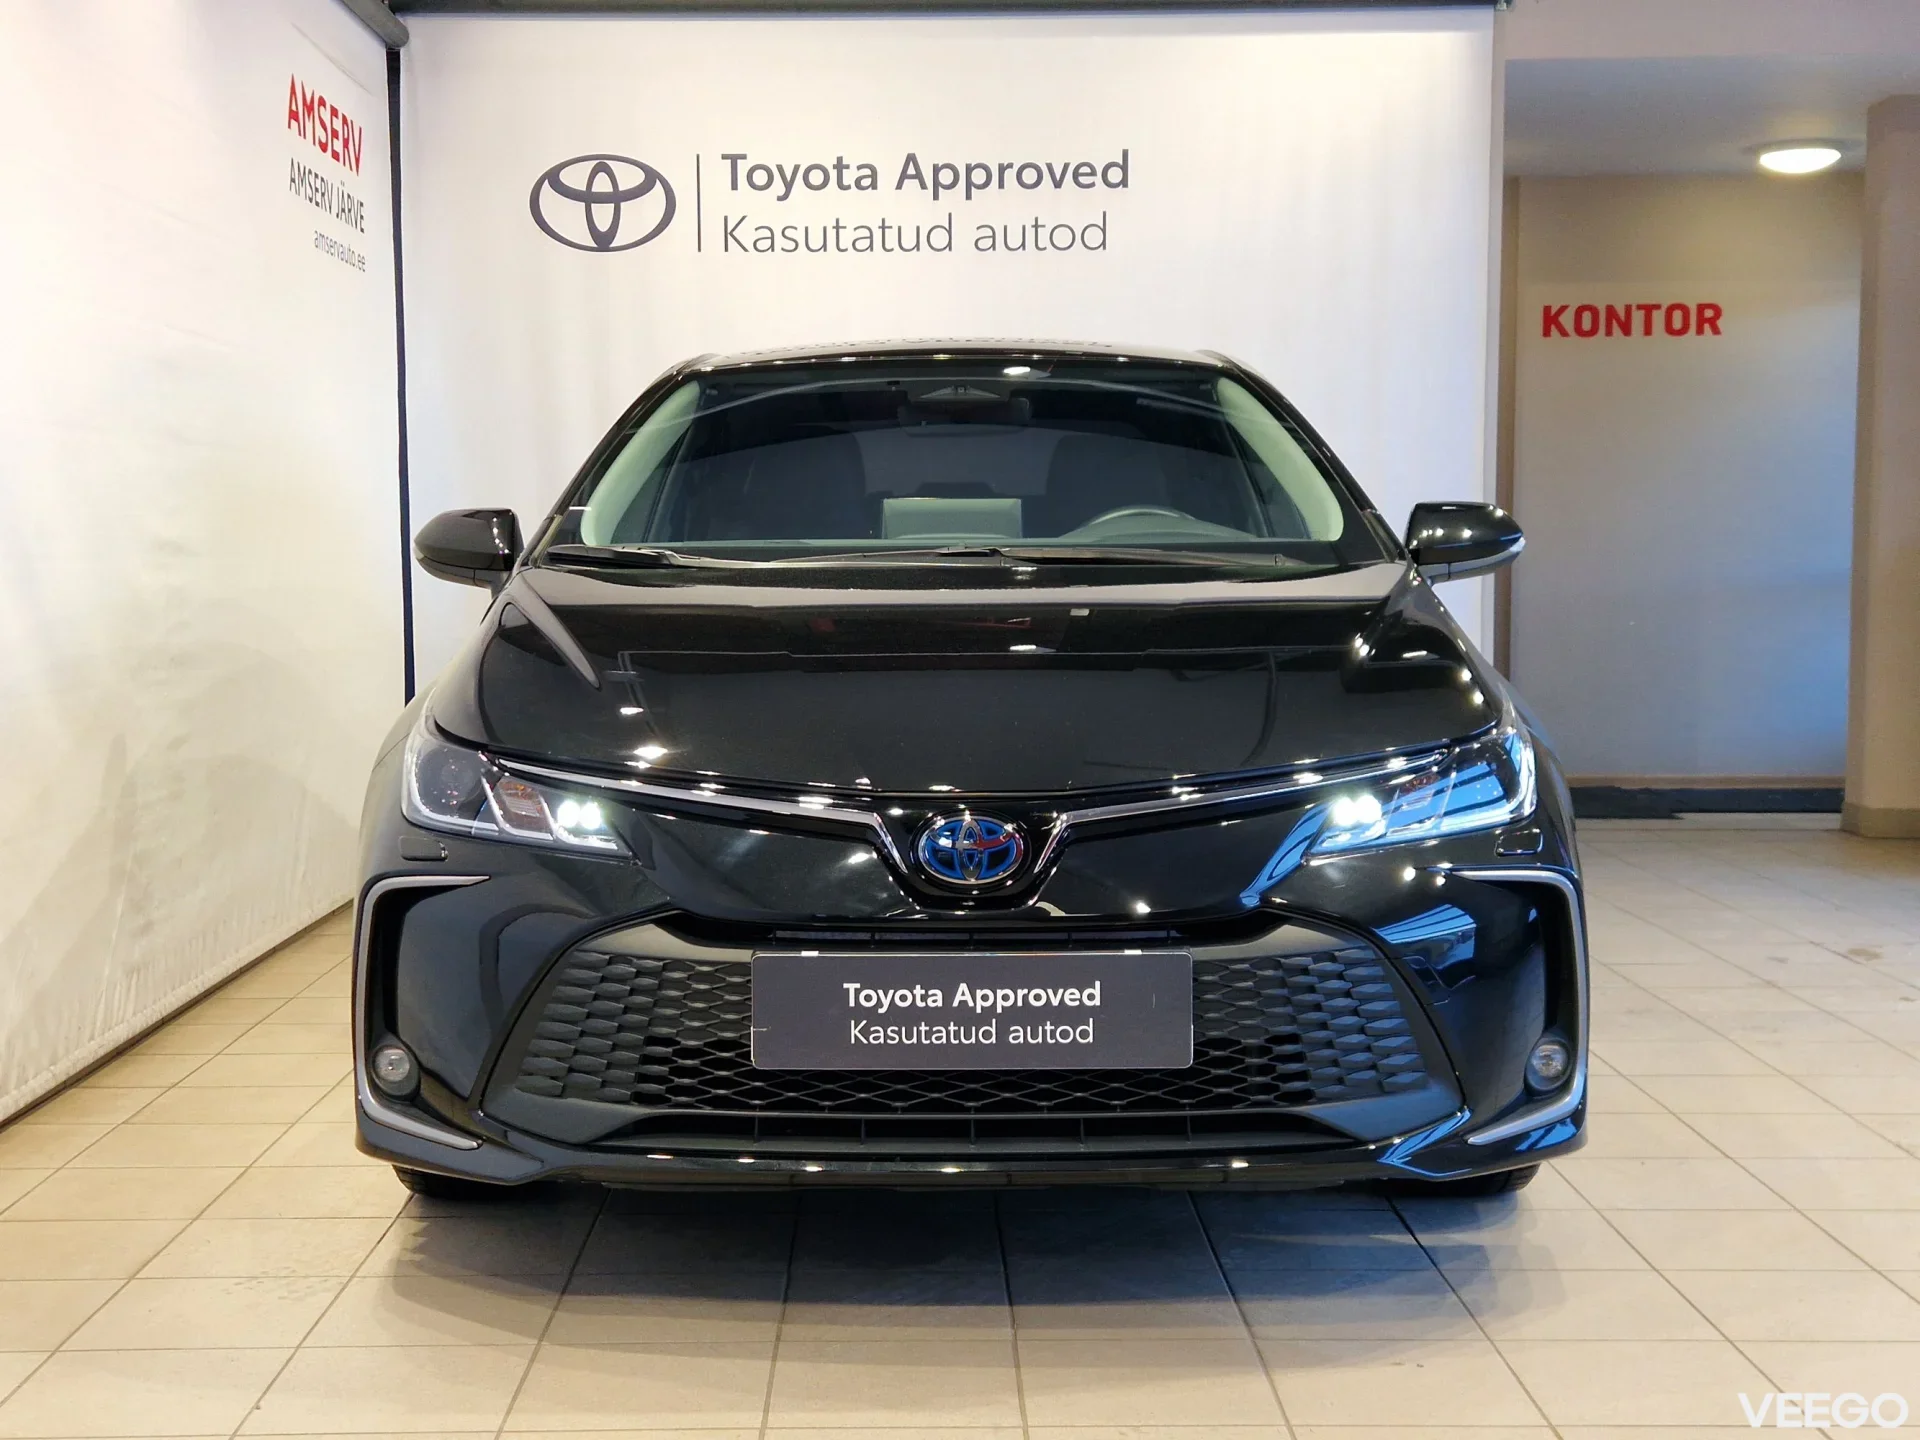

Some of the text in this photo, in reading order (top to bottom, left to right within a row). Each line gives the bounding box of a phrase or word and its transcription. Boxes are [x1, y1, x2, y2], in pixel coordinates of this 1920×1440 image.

[288, 73, 362, 176] AMSERV
[289, 158, 365, 234] AMSERV JÄRVE
[721, 149, 1130, 202] Toyota Approved
[314, 229, 366, 273] amservauto.ee
[723, 211, 1107, 253] Kasutatud autod
[1542, 303, 1723, 338] KONTOR
[843, 981, 1101, 1014] Toyota Approved
[850, 1018, 1094, 1044] Kasutatud autod
